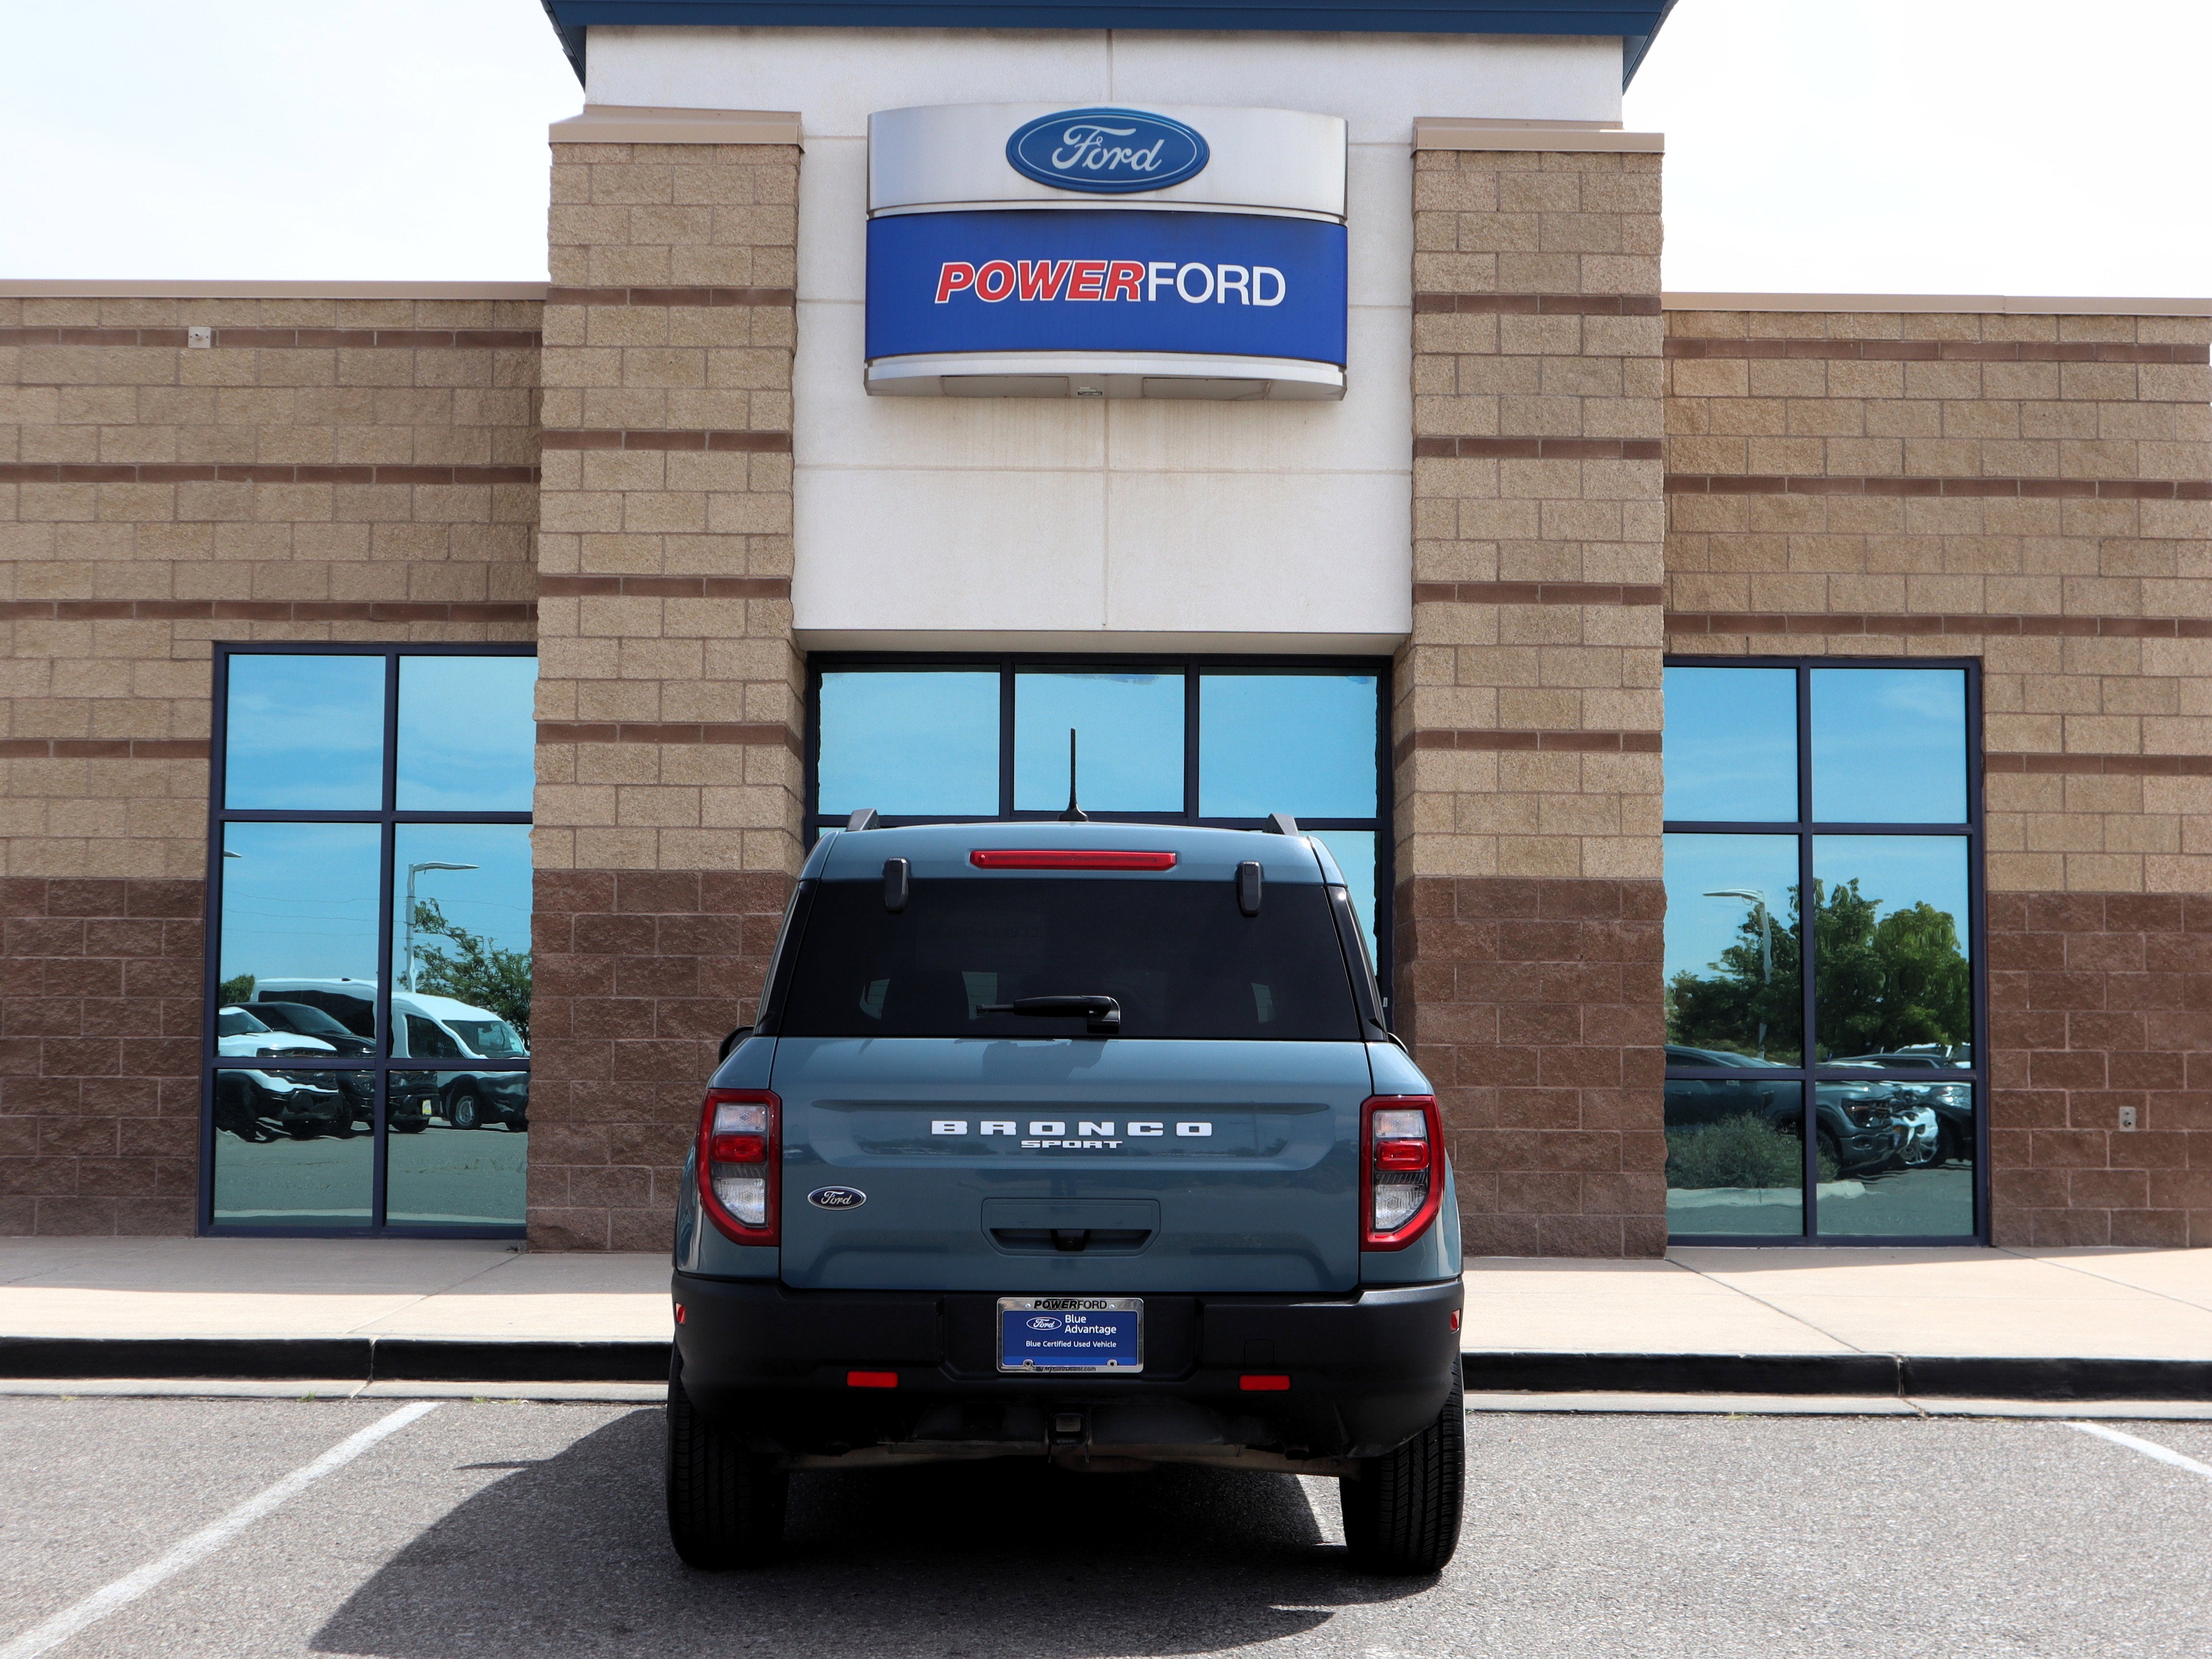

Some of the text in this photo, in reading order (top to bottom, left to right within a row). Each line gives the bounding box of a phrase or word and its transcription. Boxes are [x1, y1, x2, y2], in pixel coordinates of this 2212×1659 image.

[1052, 124, 1165, 171] Ford
[934, 259, 1286, 306] POWERFORD
[931, 1120, 1212, 1137] BRONCO
[1020, 1140, 1123, 1149] SPORT
[821, 1191, 852, 1205] Ford
[1033, 1300, 1107, 1309] POWERFORD
[1033, 1318, 1055, 1328] Ford
[1065, 1314, 1086, 1323] Blue
[1064, 1325, 1116, 1335] Advantage
